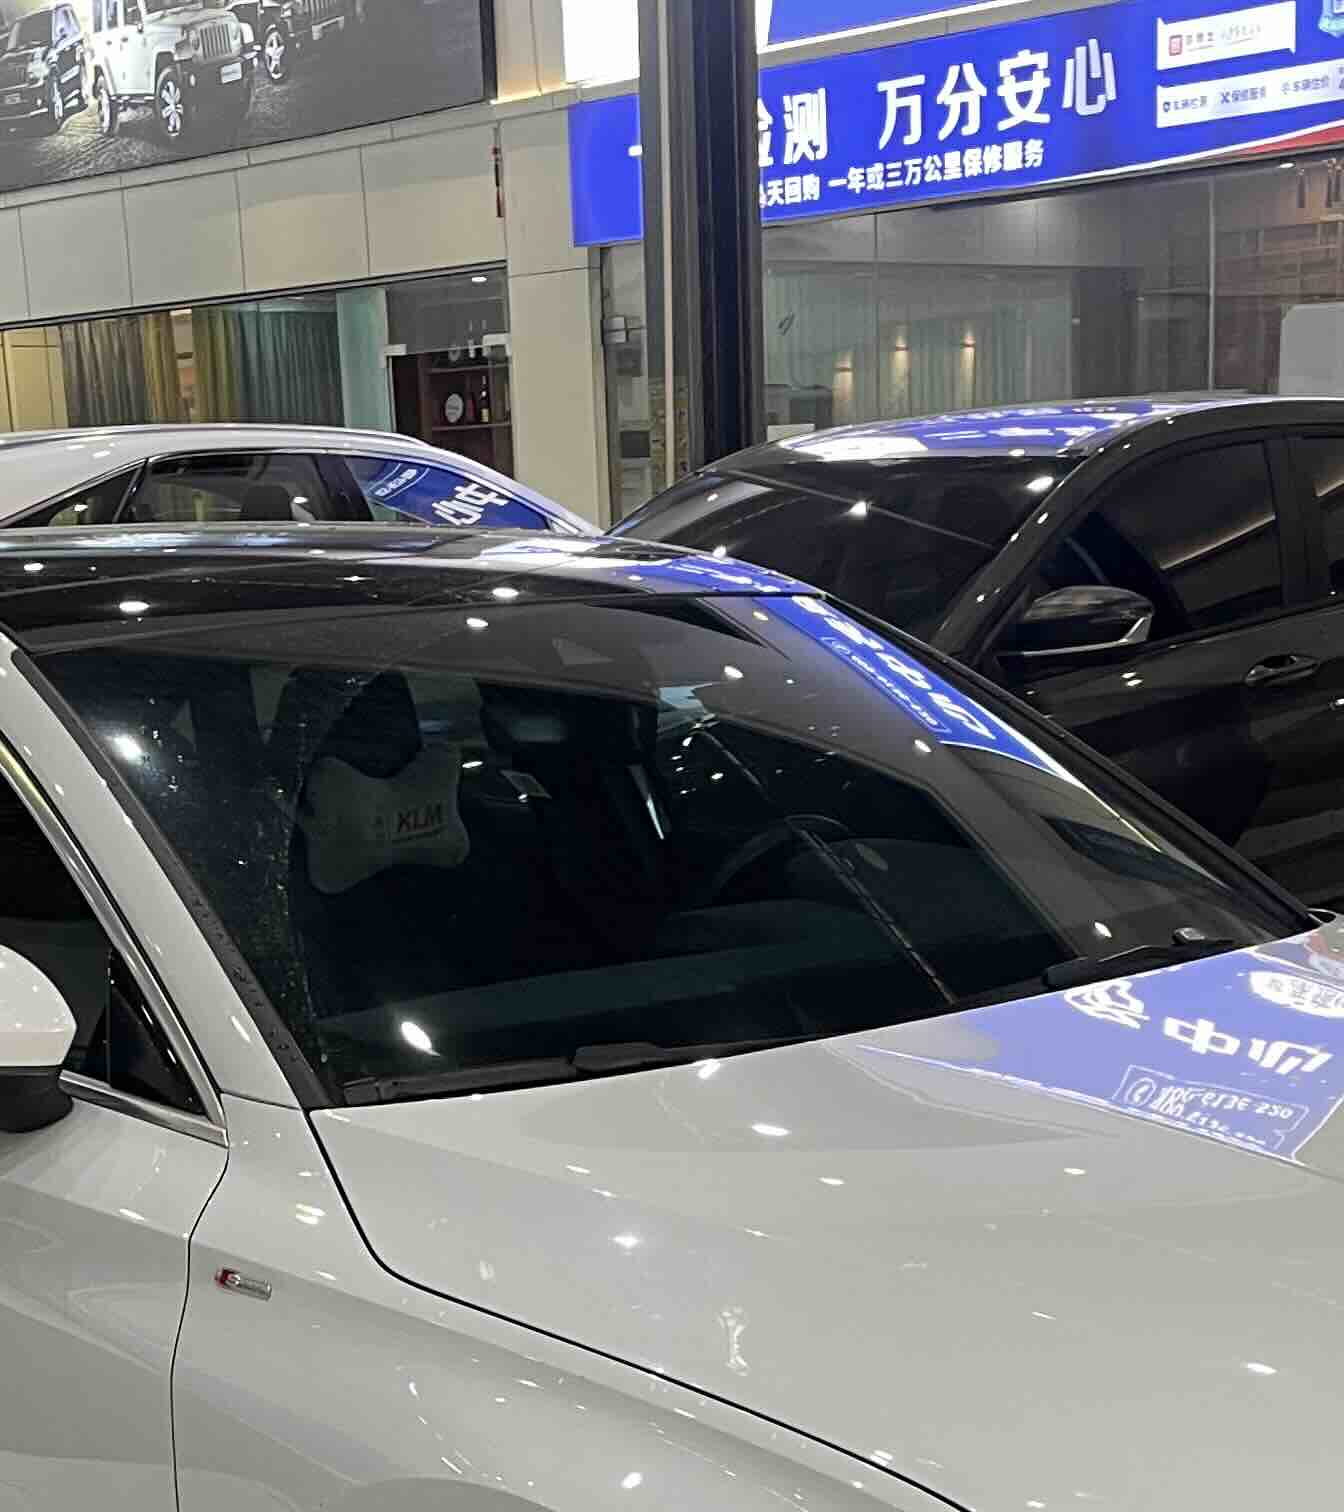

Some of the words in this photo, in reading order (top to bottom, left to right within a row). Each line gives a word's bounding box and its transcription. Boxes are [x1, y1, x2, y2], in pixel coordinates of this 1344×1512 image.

[877, 38, 1118, 152] 万分安心
[827, 138, 1046, 196] 一年或三万公里保修服务
